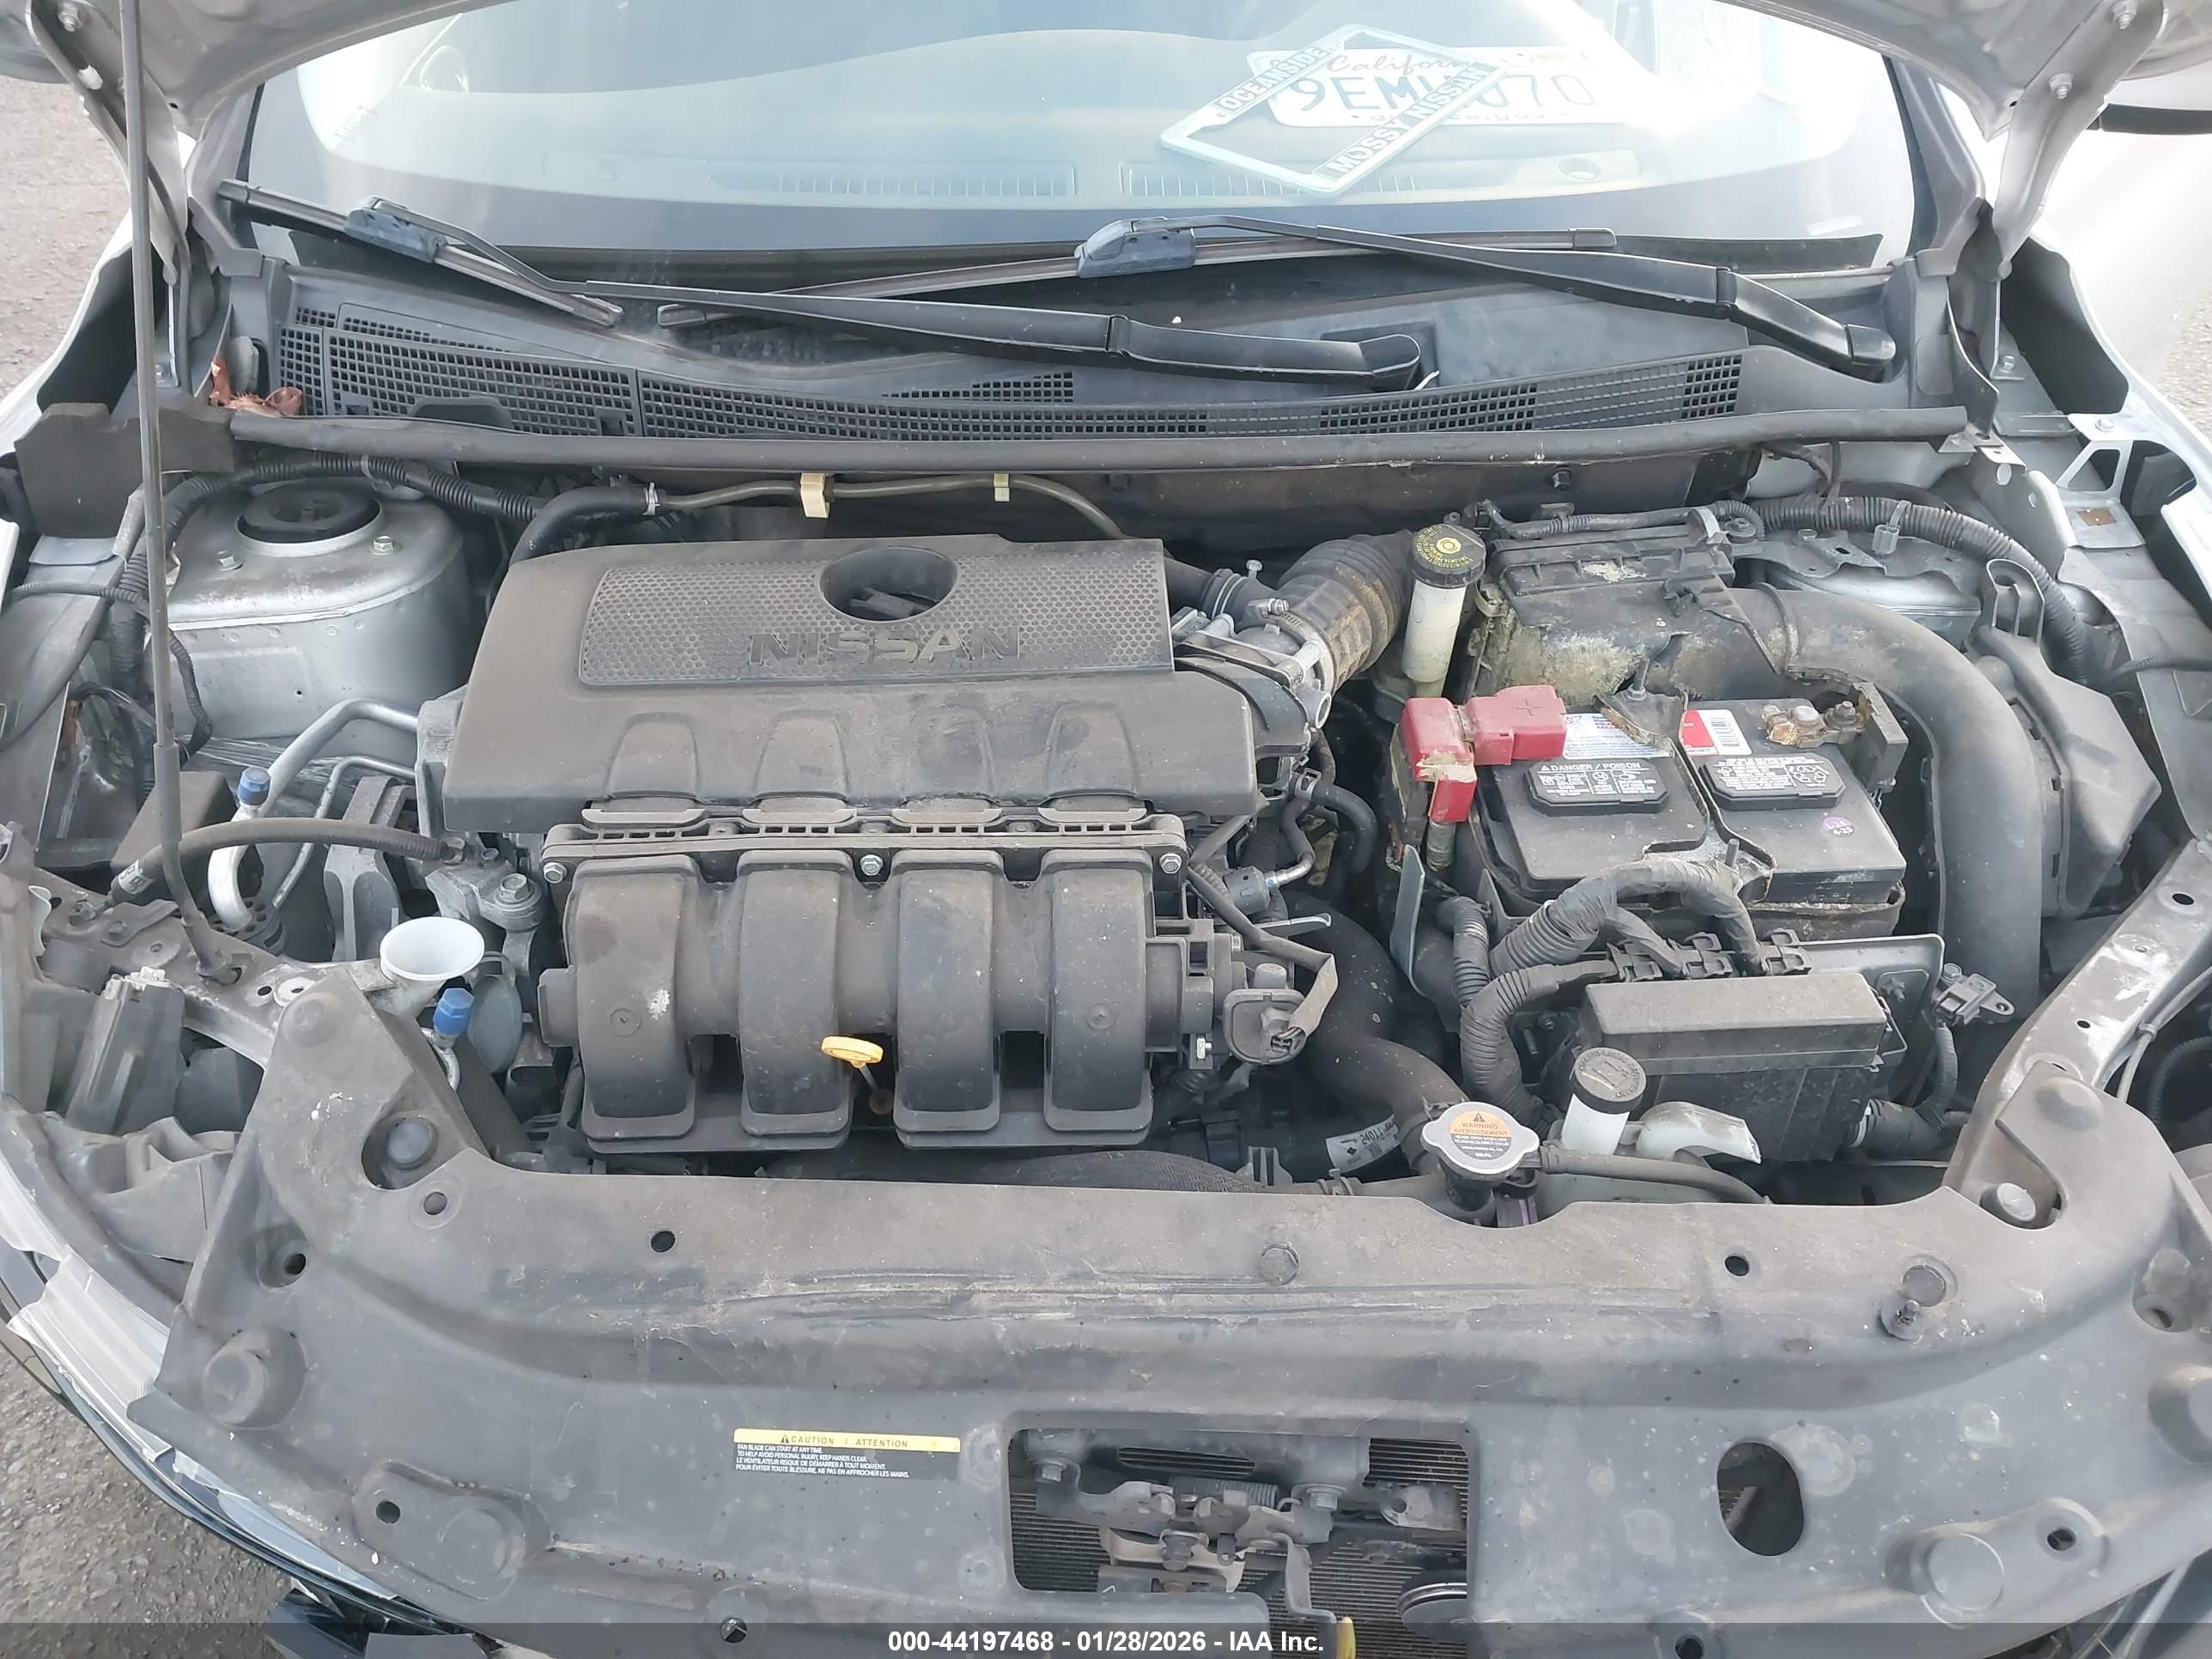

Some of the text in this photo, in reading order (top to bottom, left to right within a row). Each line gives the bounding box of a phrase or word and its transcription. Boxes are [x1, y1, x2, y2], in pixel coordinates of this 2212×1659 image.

[1219, 45, 1330, 111] OCEANSIDE
[1326, 64, 1493, 173] MOSSY NISSAN
[749, 625, 1024, 666] NISSAN
[1462, 1121, 1498, 1130] WARNING
[791, 1436, 834, 1444] CAUTION
[855, 1438, 908, 1448] ATTENTION
[808, 1460, 839, 1468] DÉMARRER
